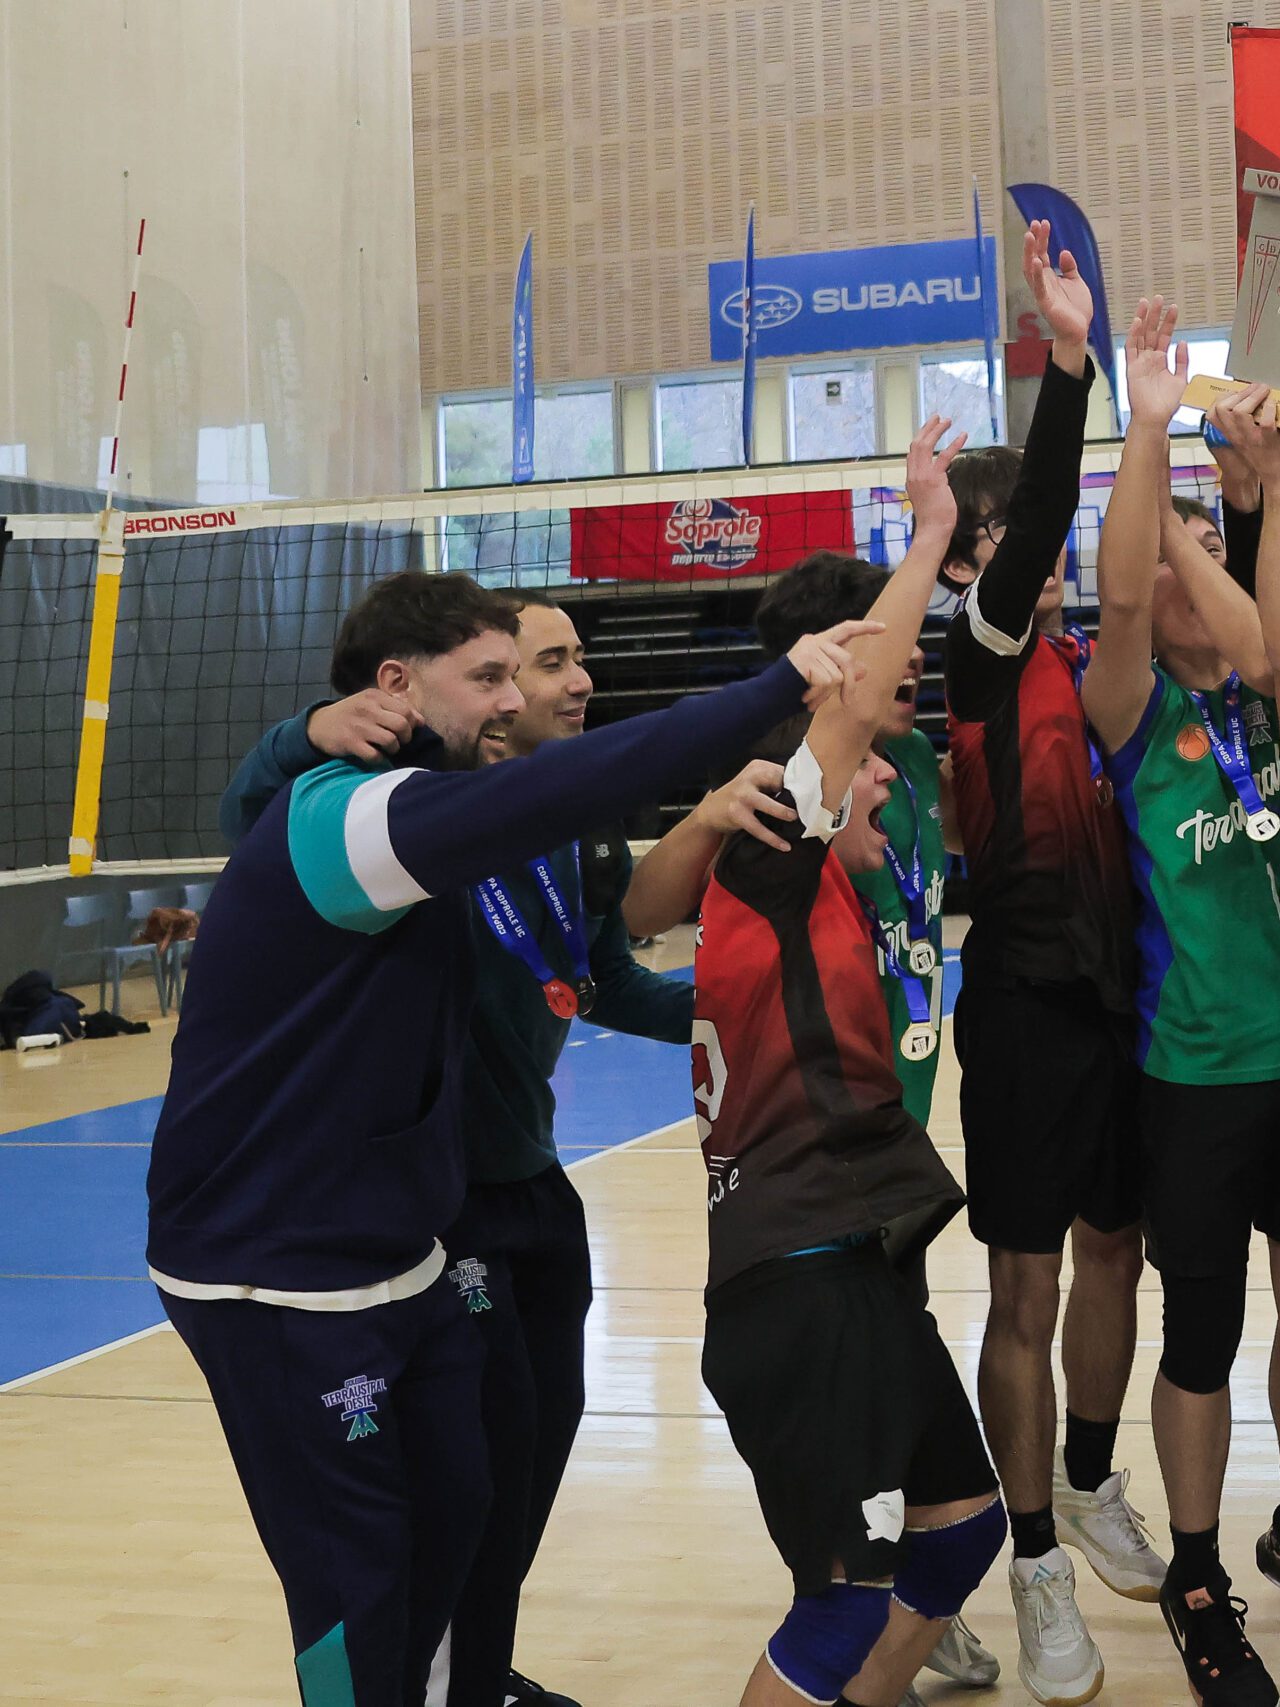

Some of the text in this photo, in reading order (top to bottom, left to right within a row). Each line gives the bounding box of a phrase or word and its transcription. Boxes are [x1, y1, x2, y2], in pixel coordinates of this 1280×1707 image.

[813, 276, 981, 313] SUBARU
[124, 511, 235, 533] BRONSON
[666, 509, 761, 548] Soprole
[1204, 720, 1220, 747] SOPROLE
[1232, 717, 1244, 760] SOPROLE UC
[1218, 747, 1232, 765] COPA
[487, 877, 526, 938] PA SOPROLE UC
[537, 865, 572, 933] COPA SOPROLE UC
[491, 913, 507, 935] COPA
[323, 1378, 387, 1407] TERRAUSTRAL
[346, 1395, 373, 1411] OESTE
